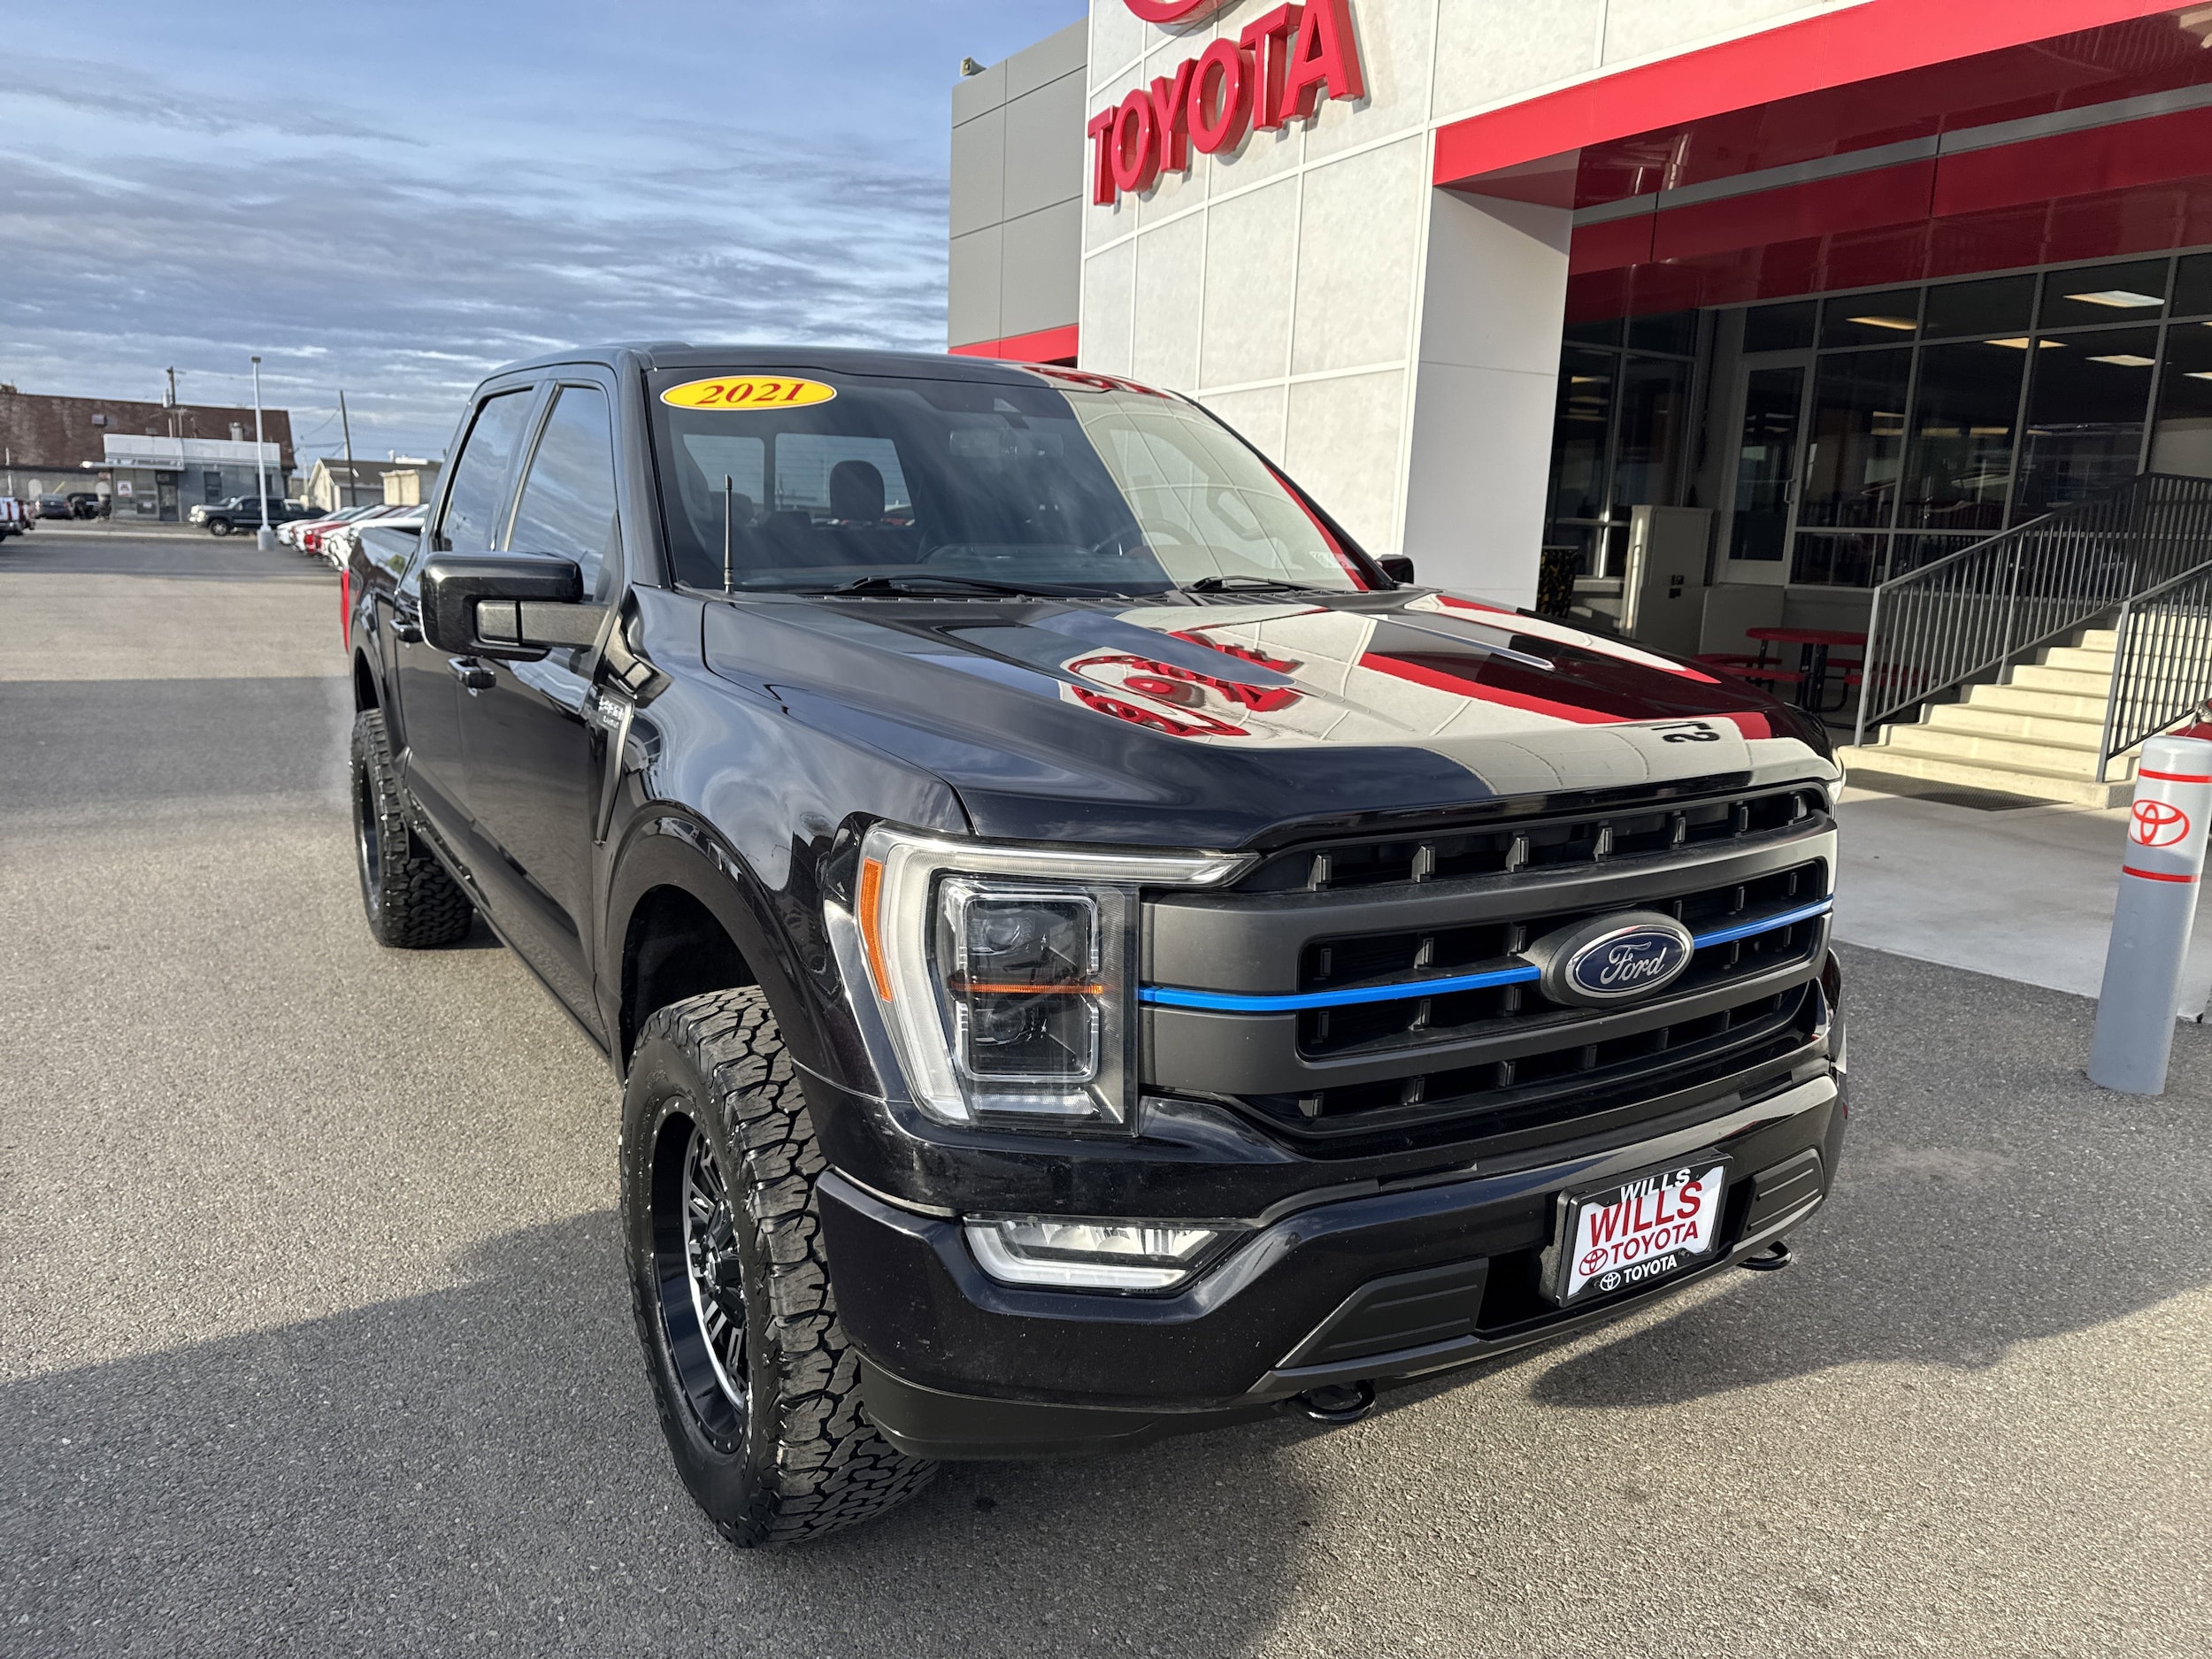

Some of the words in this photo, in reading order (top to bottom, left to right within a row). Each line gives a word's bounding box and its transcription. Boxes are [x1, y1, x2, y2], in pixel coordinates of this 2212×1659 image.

[1088, 0, 1365, 207] TOYOTA
[695, 382, 805, 405] 2021
[1600, 941, 1668, 985] Ford
[1620, 1168, 1692, 1203] WILLS
[1590, 1181, 1702, 1248] WILLS
[1611, 1220, 1699, 1264] TOYOTA
[1624, 1254, 1678, 1284] TOYOTA
